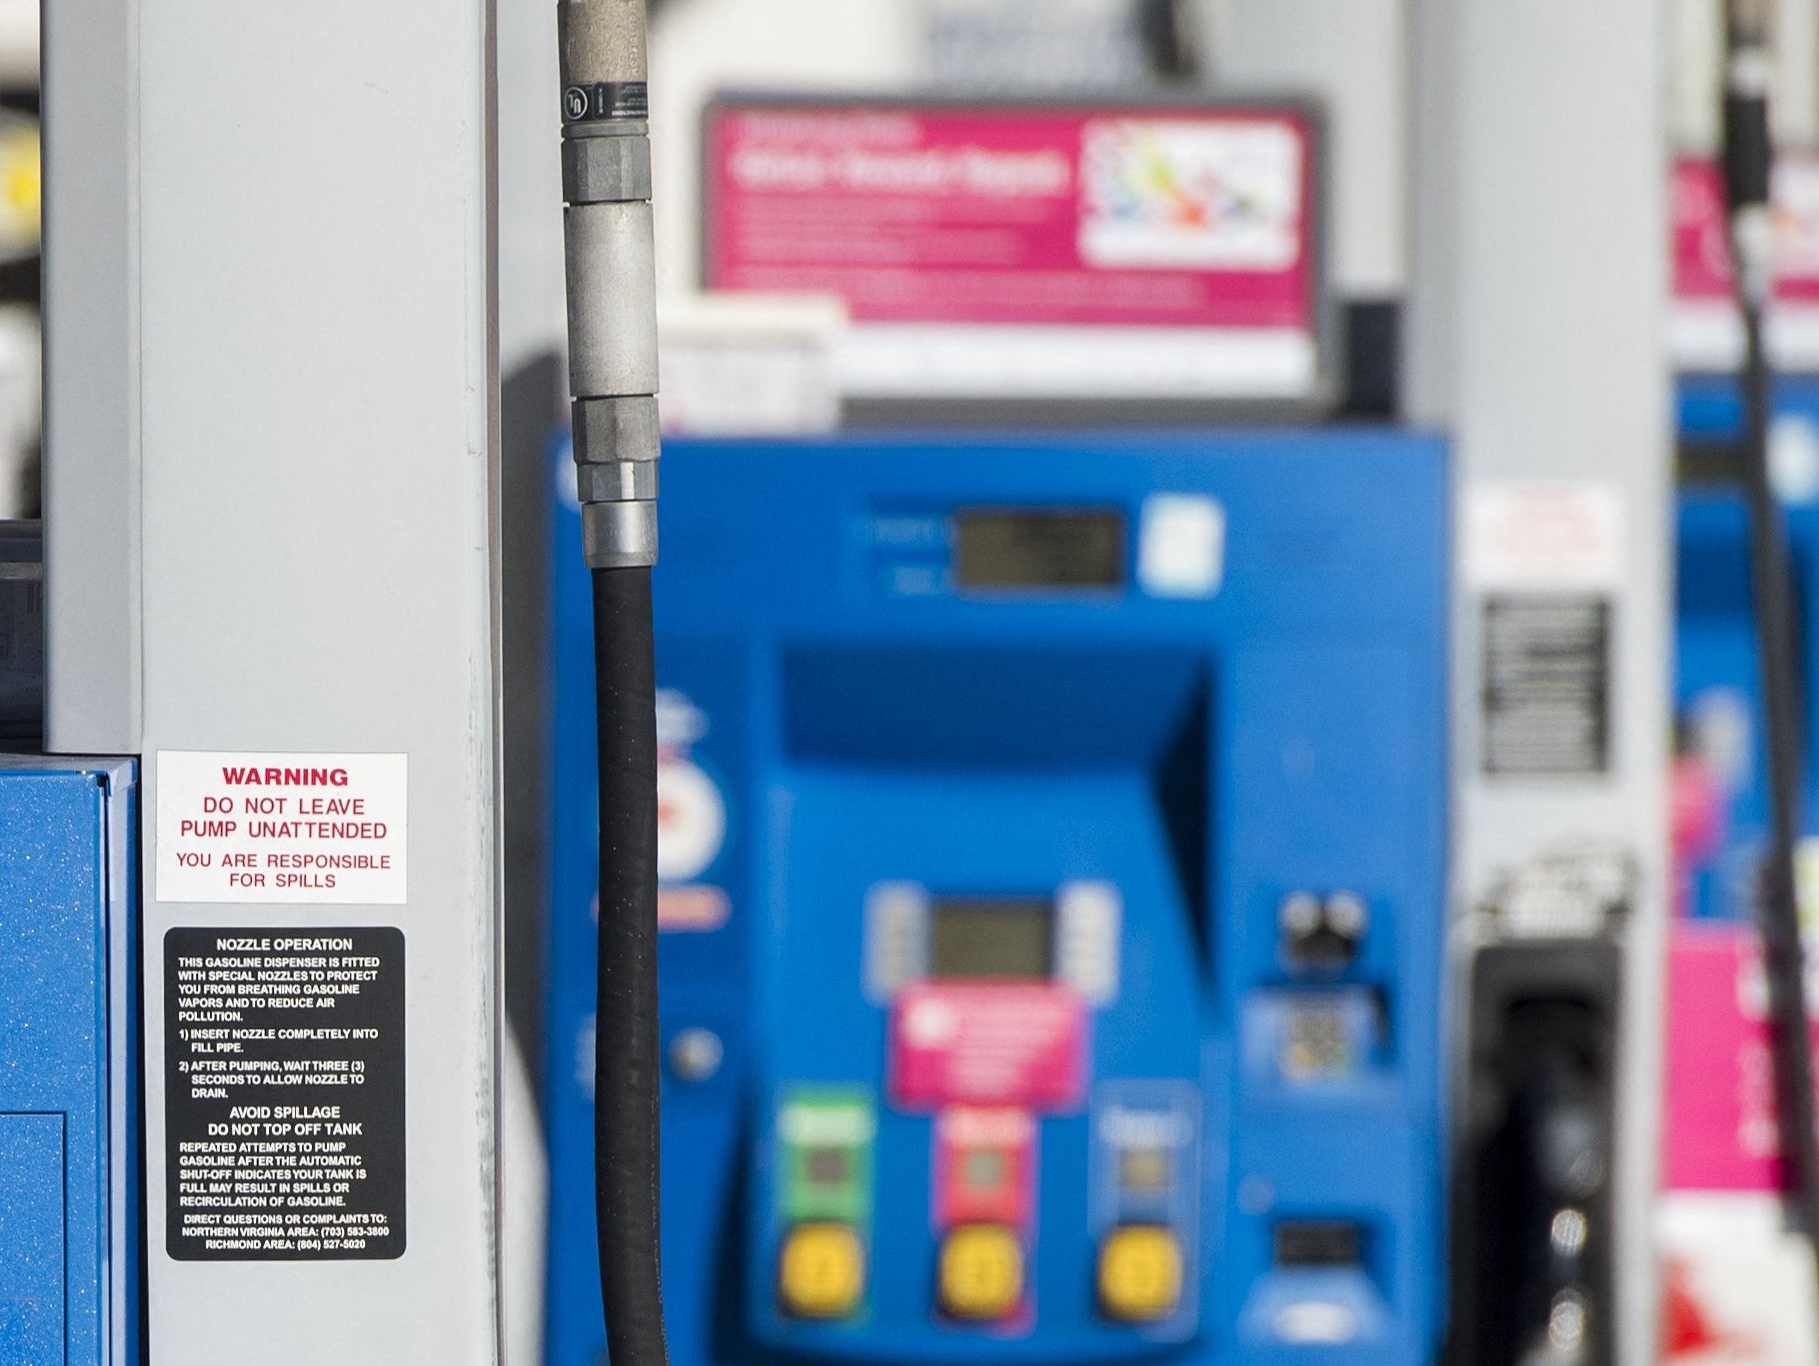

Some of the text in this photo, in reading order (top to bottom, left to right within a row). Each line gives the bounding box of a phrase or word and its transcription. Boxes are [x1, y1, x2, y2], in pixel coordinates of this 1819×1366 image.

[222, 768, 348, 786] WARNING
[203, 797, 365, 814] DO NOT LEAVE
[181, 820, 387, 839] PUMP UNATTENDED
[176, 853, 391, 869] YOU ARE RESPONSIBLE
[230, 873, 336, 888] FOR SPILLS
[216, 938, 353, 950] NOZZLE OPERATION
[179, 957, 380, 968] THIS GASOLINE DISPENSER IS FITTED
[178, 971, 377, 981] WITH SPECIAL NOZZLES TO PROTECT
[179, 984, 360, 994] YOU FROM BREATHING GASOLINE
[179, 998, 335, 1008] VAPORS AND TO REDUCE AIR
[179, 1012, 243, 1021] POLLUTION.
[230, 1106, 340, 1119] AVOID SPILLAGE
[208, 1123, 363, 1136] DO NOT TOP OFF TANK
[206, 1240, 366, 1251] RICHMOND AREA: (804) 527-5020
